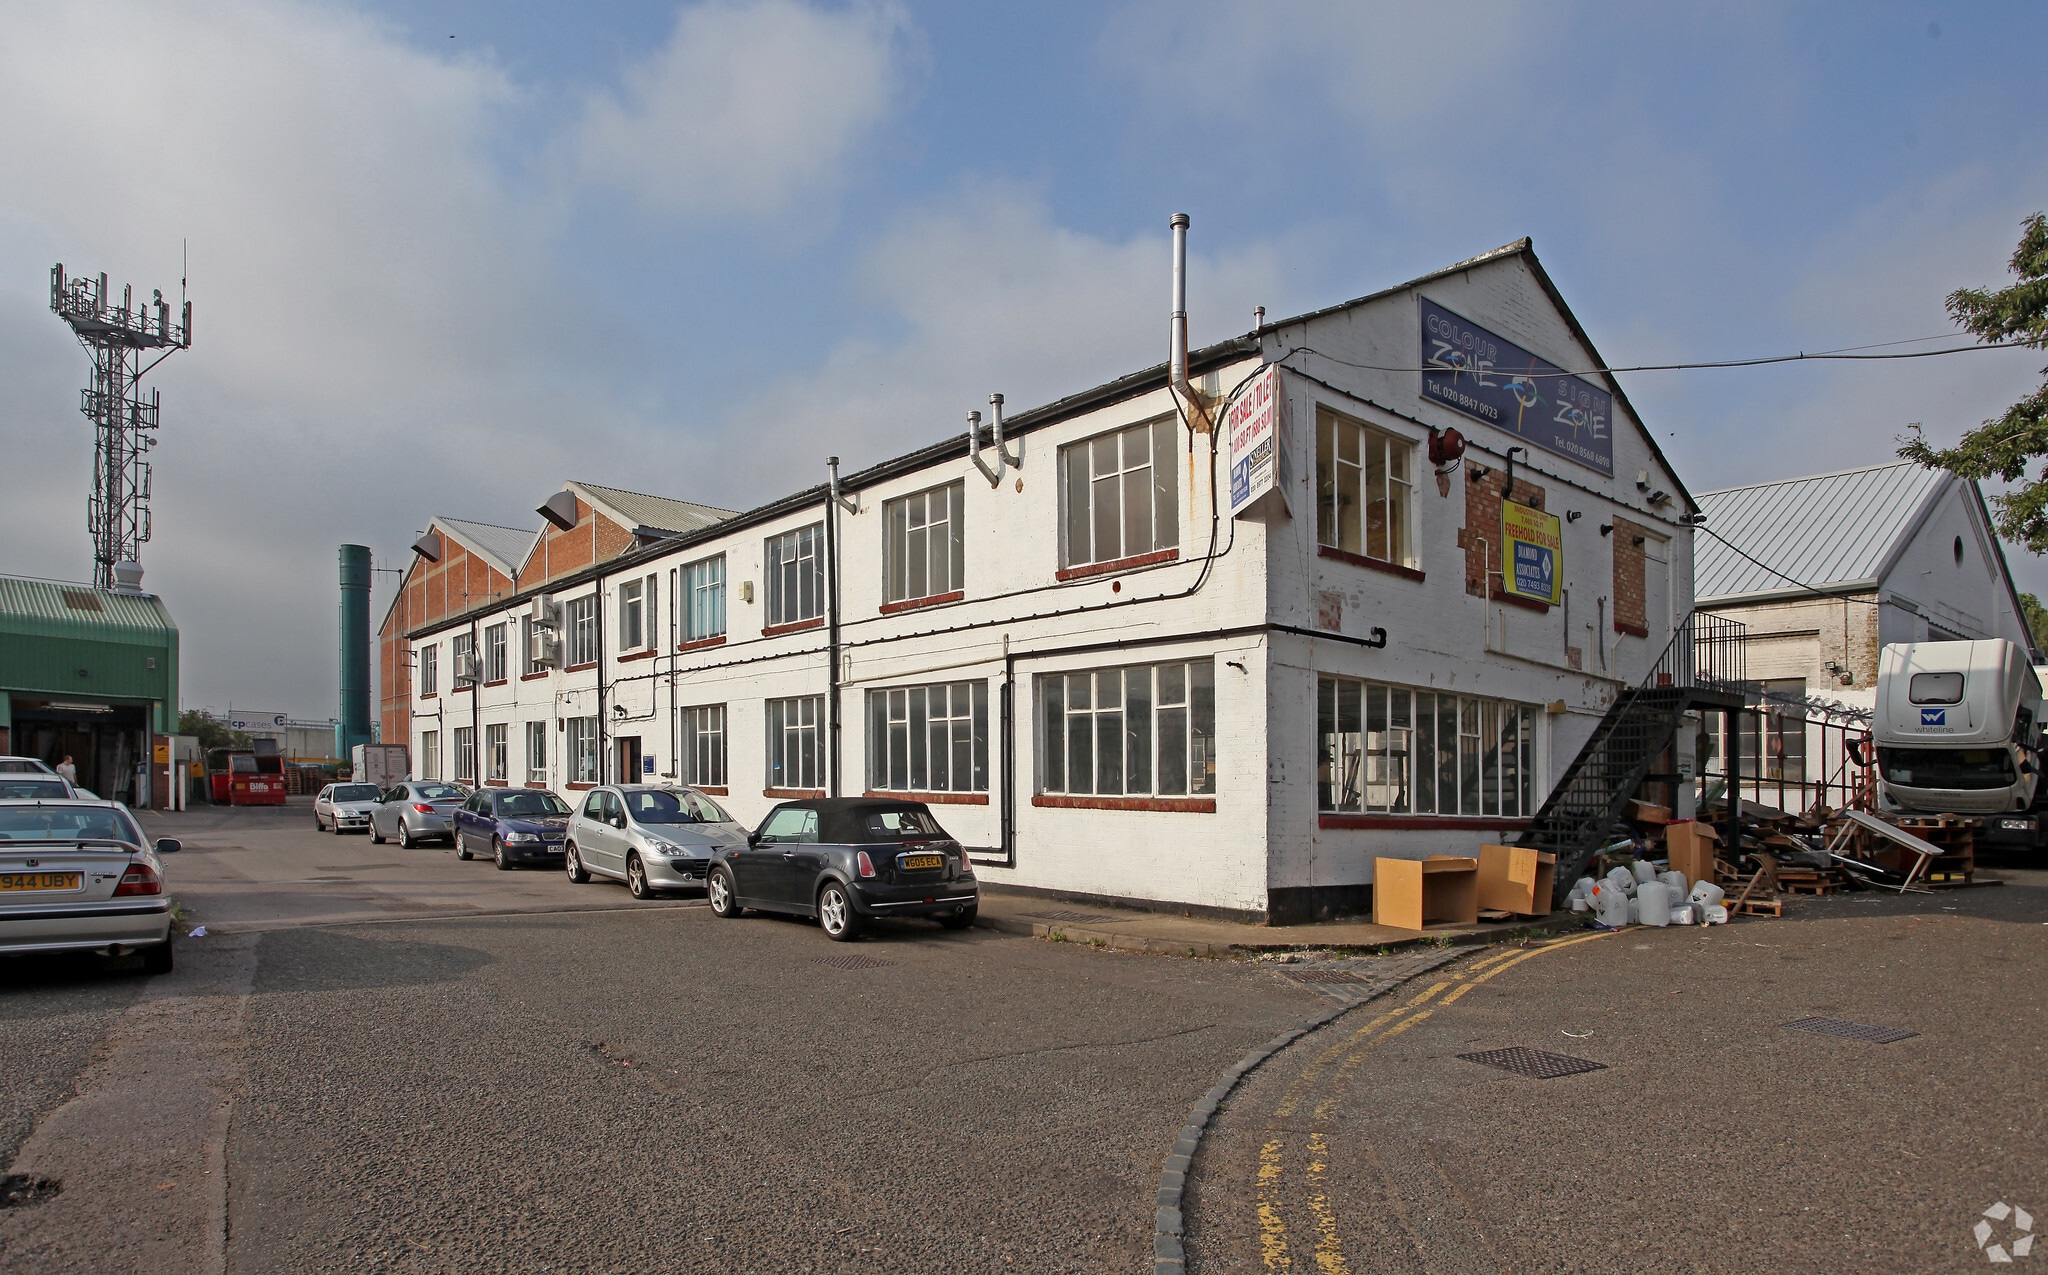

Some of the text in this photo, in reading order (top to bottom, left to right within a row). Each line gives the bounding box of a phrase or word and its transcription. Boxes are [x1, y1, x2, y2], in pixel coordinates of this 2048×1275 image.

[1428, 314, 1497, 362] COLOUR
[1428, 339, 1497, 387] ZONE
[1231, 405, 1239, 432] FOR
[1240, 392, 1252, 425] SALE
[1256, 382, 1262, 410] TO
[1263, 371, 1272, 403] LET
[1428, 380, 1498, 419] Tel. 020 8847 0923
[1558, 379, 1606, 416] SIGN
[1553, 400, 1608, 439] ZONE
[1250, 438, 1271, 468] SNELLER
[1554, 435, 1565, 449] Tel.
[1566, 441, 1578, 455] 020
[1505, 522, 1559, 550] FREEHOLD FOR SALE
[1518, 545, 1537, 561] DIAMOND
[1516, 562, 1540, 579] ASSOCIATES
[1517, 577, 1527, 587] 020
[1527, 579, 1540, 590] 7493
[926, 856, 941, 866] ECA
[2, 875, 37, 889] 944
[41, 873, 76, 887] UBY
